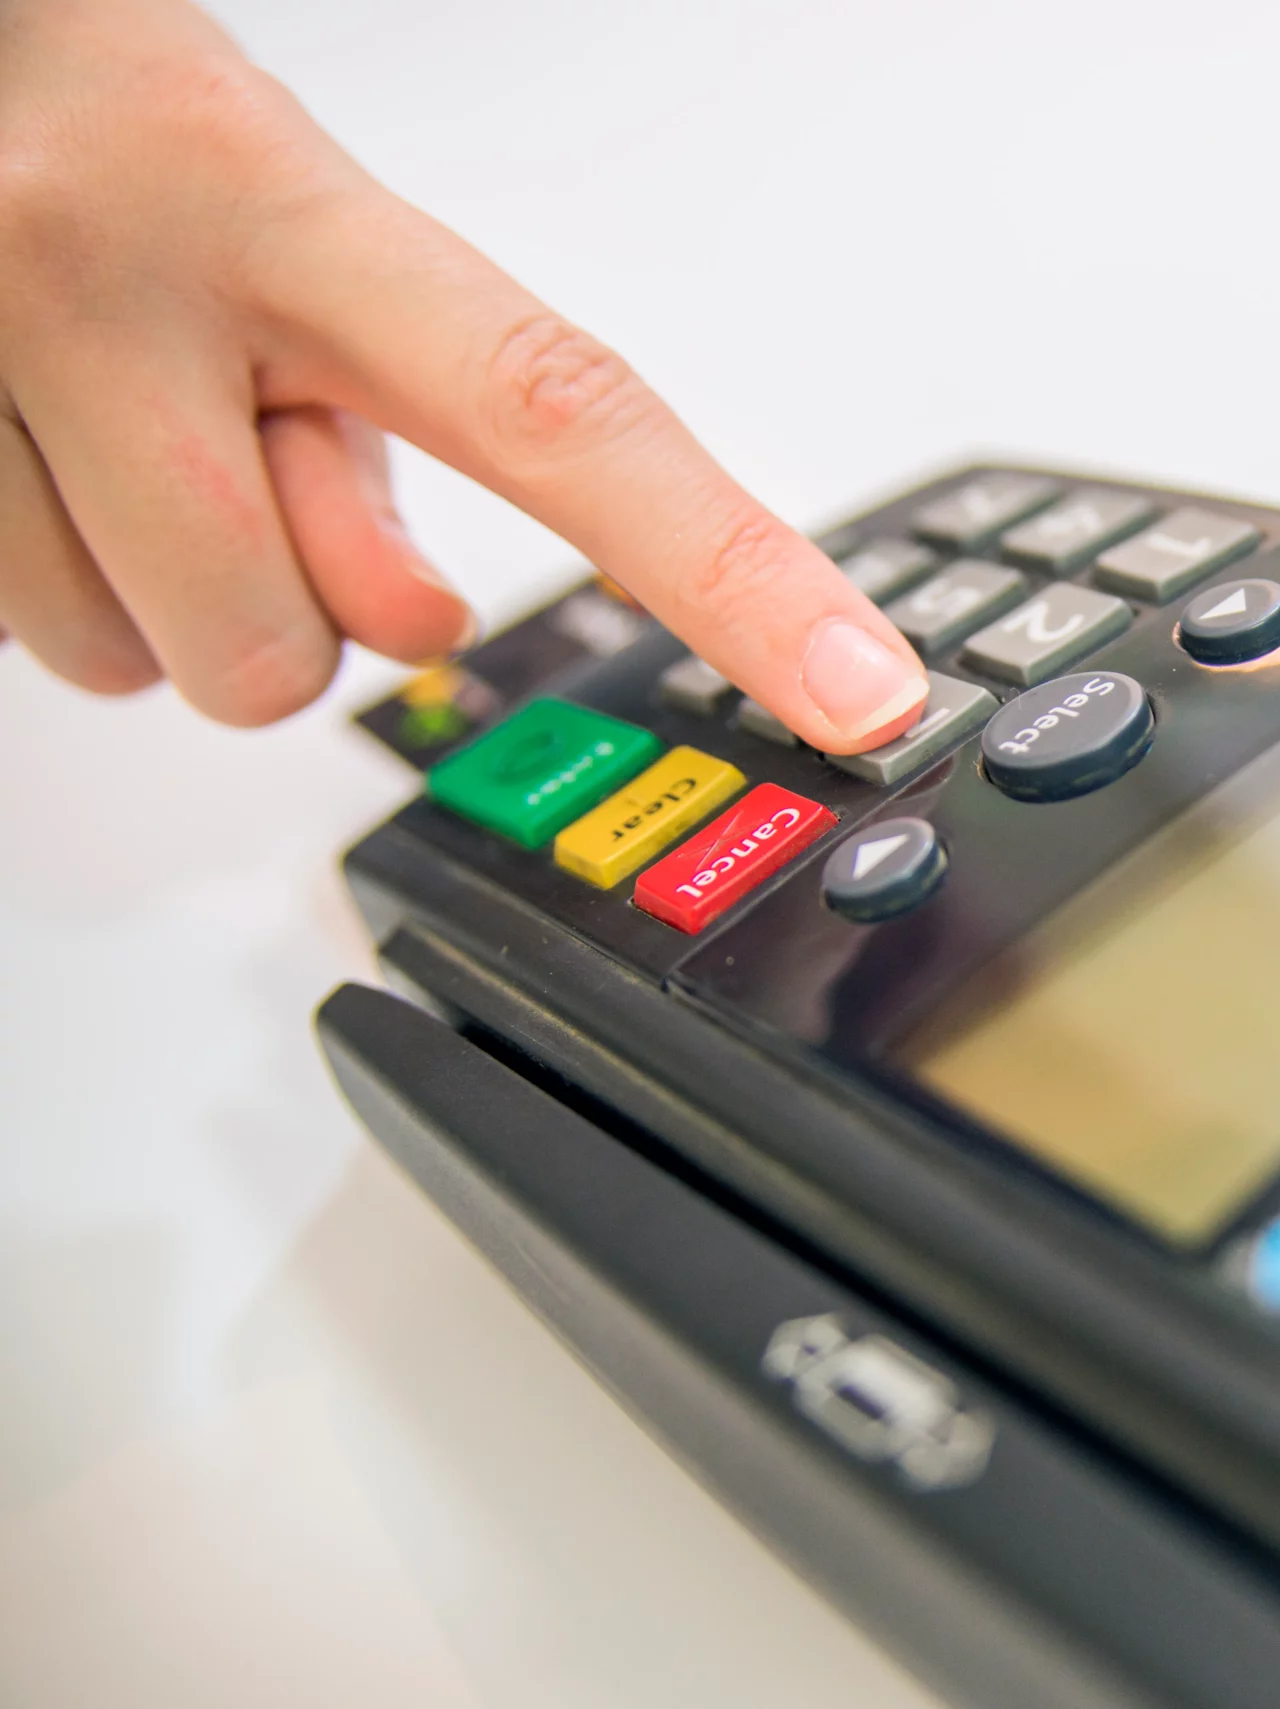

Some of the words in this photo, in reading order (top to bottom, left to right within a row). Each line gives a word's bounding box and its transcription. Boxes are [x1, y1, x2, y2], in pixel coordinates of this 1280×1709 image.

[1147, 531, 1211, 557] 1
[1001, 600, 1085, 643] 2
[998, 677, 1116, 755] Select
[610, 777, 698, 842] Clear
[675, 807, 801, 899] Cancel
